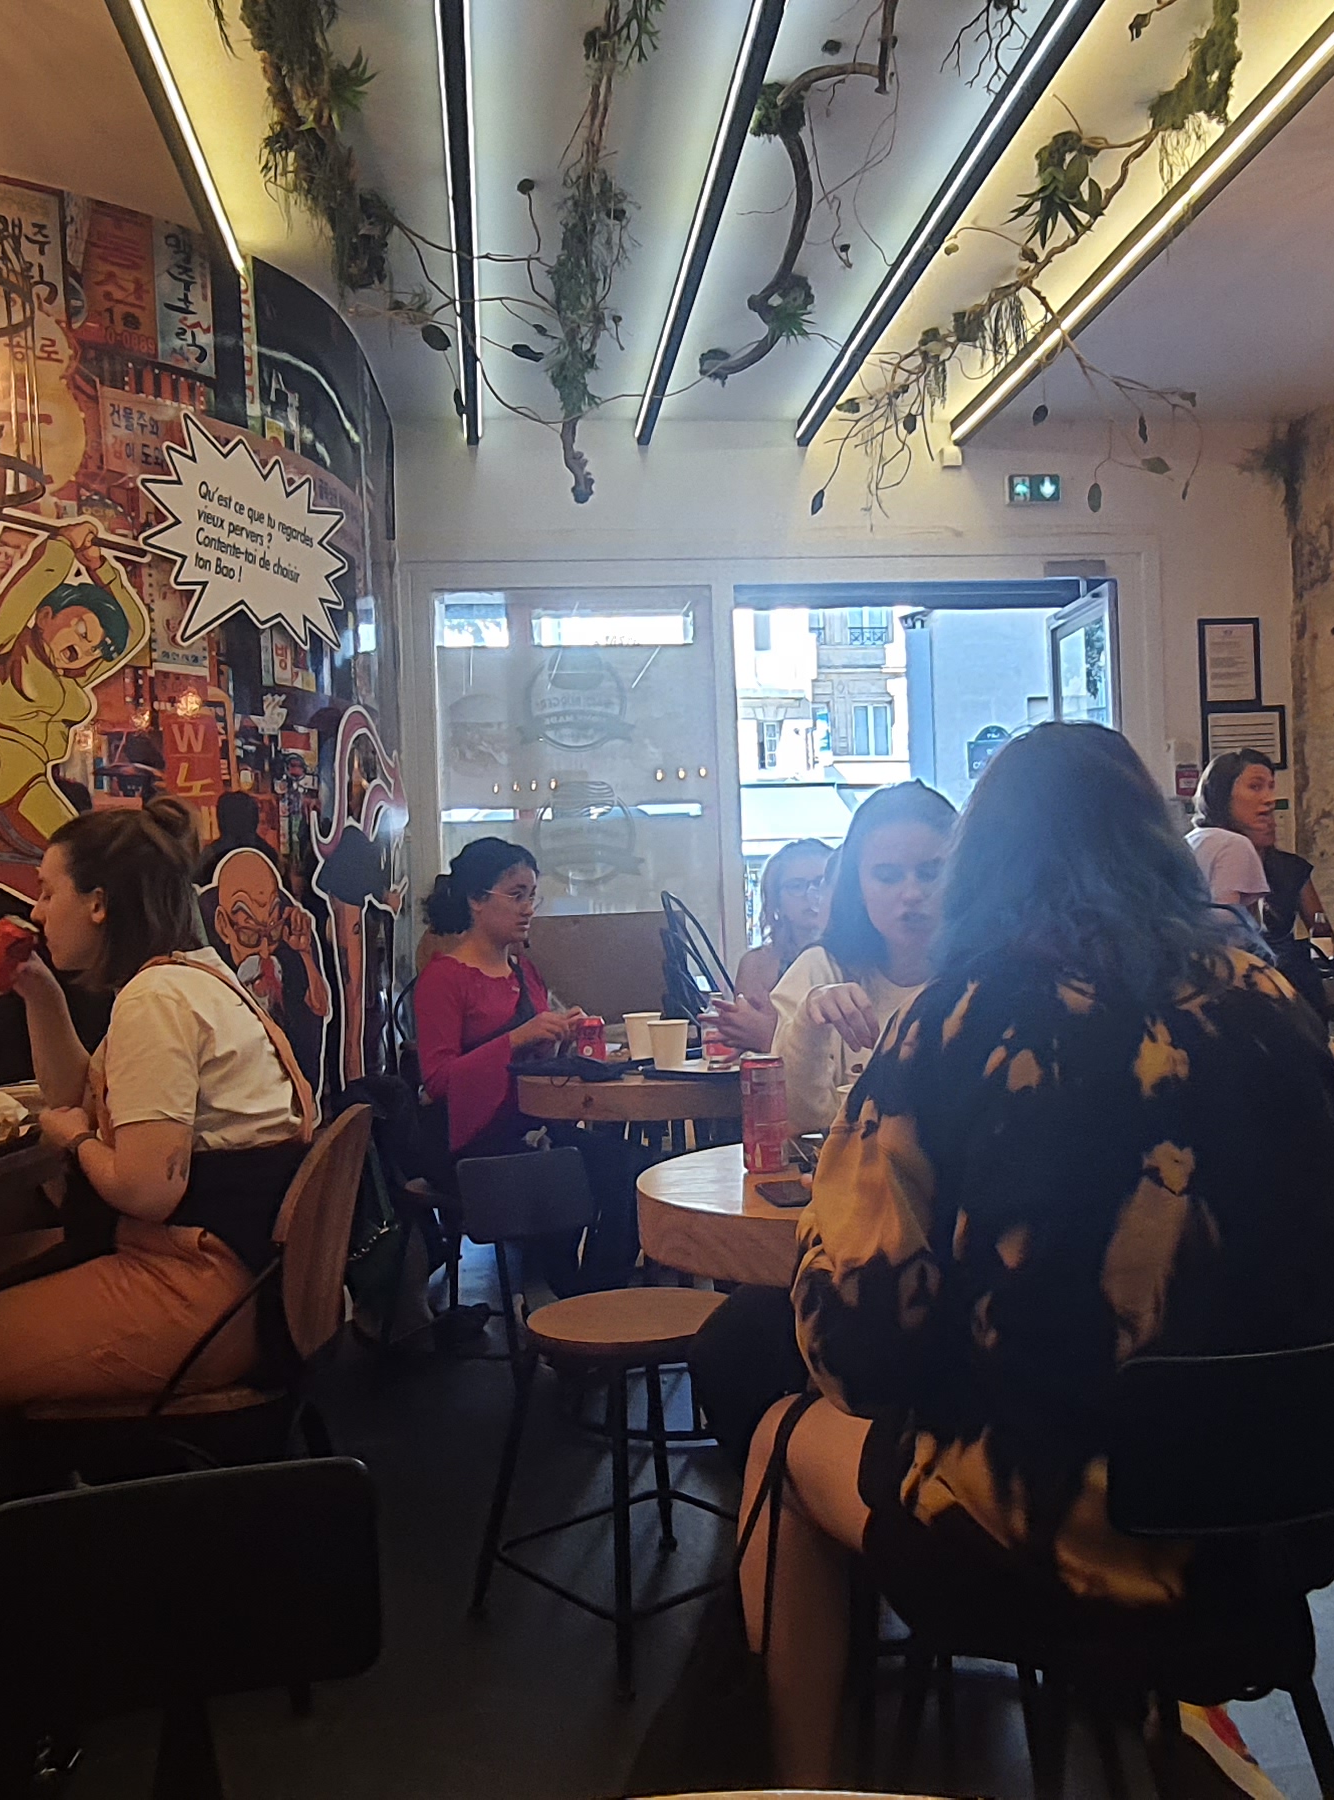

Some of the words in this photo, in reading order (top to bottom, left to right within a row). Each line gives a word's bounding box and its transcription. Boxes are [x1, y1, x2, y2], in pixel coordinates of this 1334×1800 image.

[197, 505, 226, 530] vieux
[227, 521, 264, 546] pervers
[267, 532, 273, 549] ?
[234, 501, 246, 515] ce
[247, 507, 265, 524] que
[267, 512, 276, 529] tu
[277, 520, 314, 548] regardes
[194, 552, 212, 572] ton
[214, 557, 236, 580] Bao
[238, 565, 243, 583] !
[196, 527, 257, 565] Contente-toi
[259, 550, 270, 571] de
[273, 557, 300, 583] choisir
[172, 723, 205, 752] W
